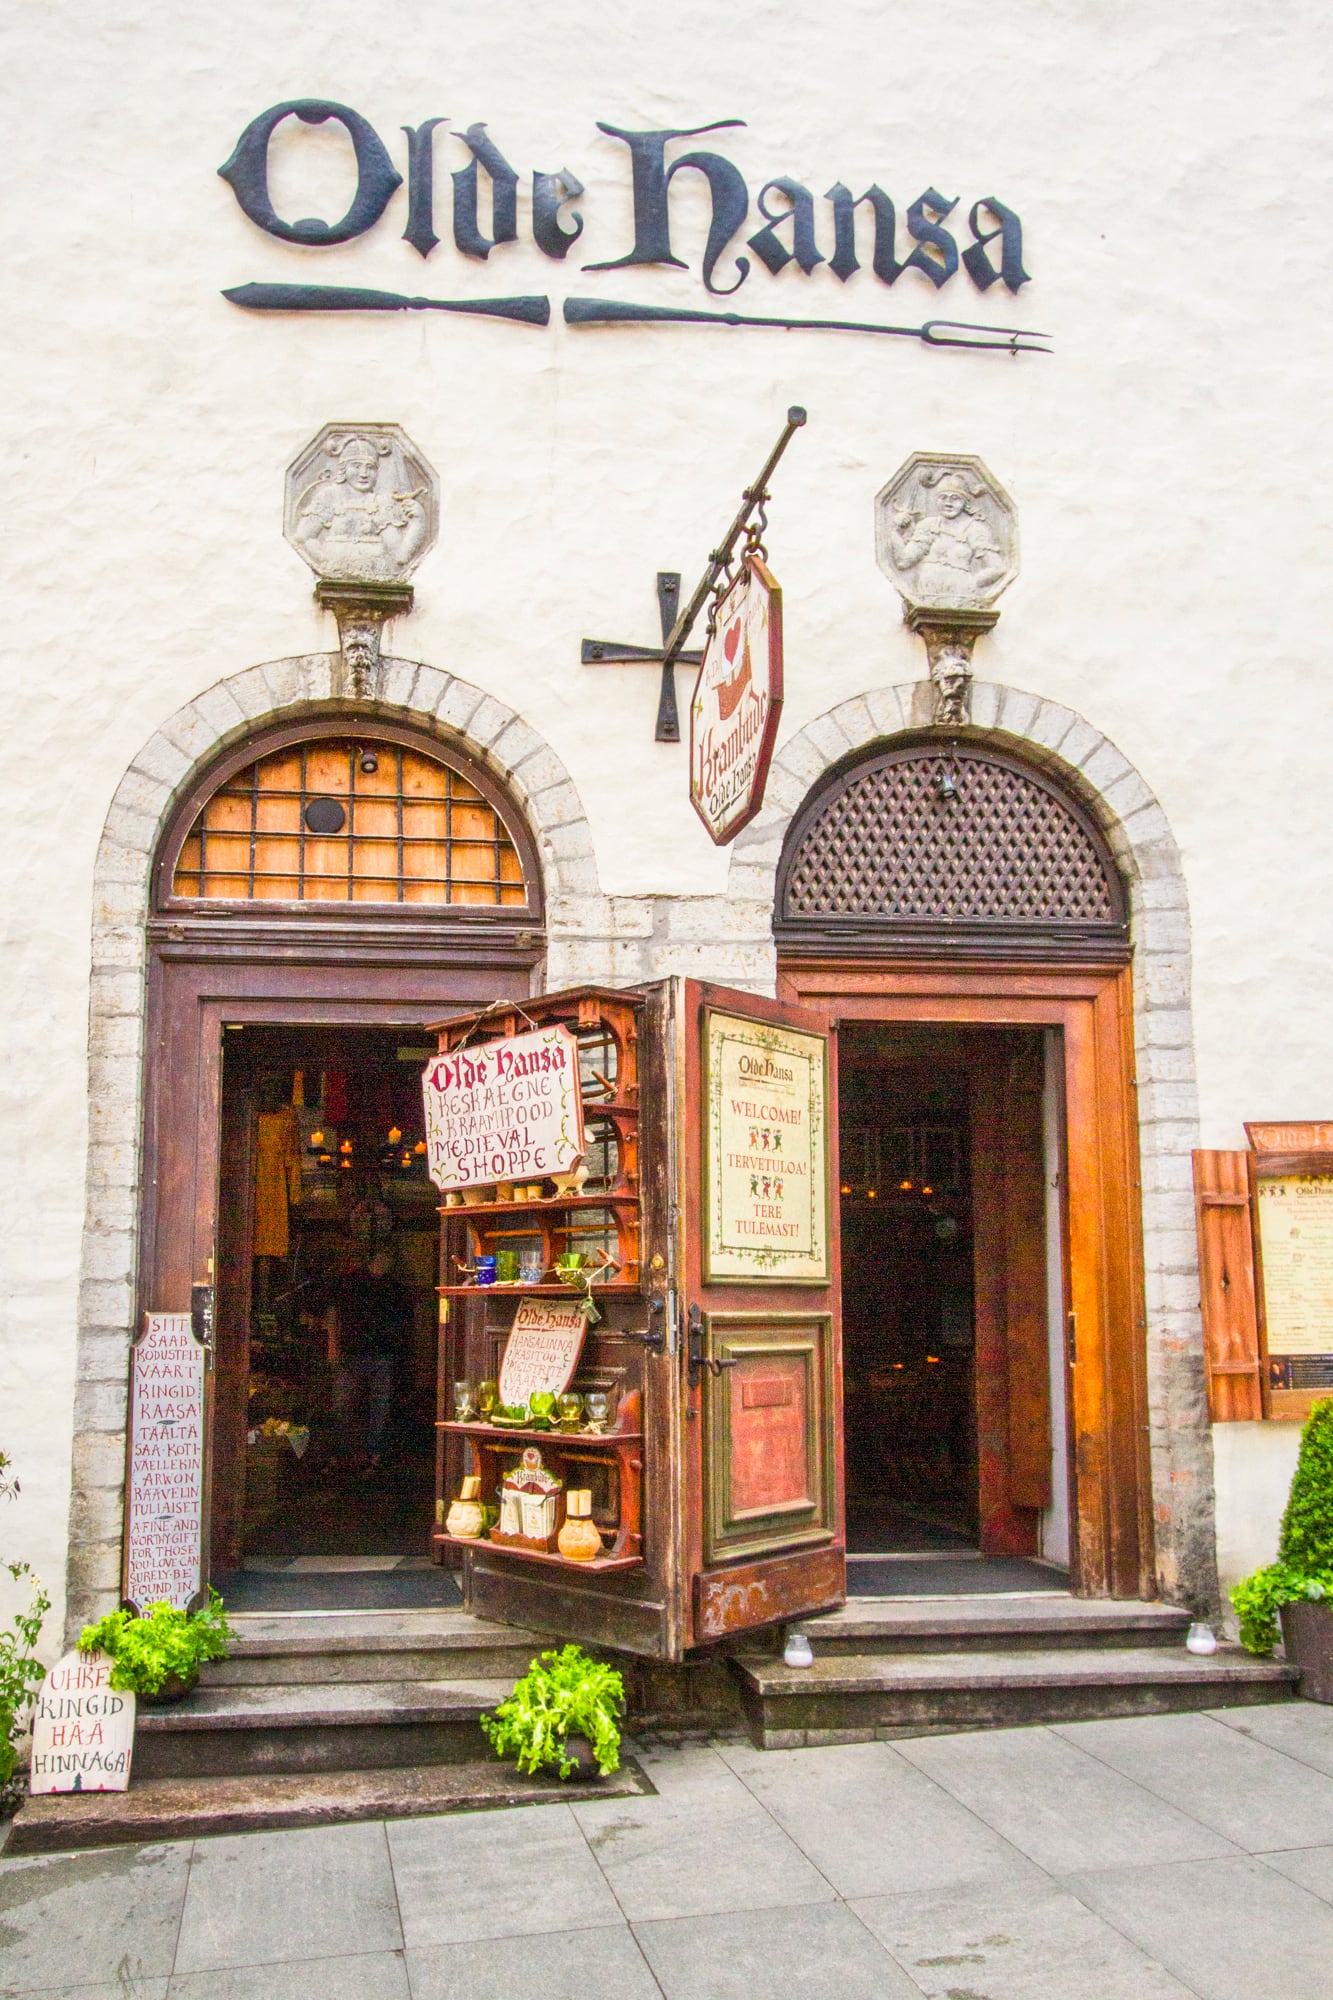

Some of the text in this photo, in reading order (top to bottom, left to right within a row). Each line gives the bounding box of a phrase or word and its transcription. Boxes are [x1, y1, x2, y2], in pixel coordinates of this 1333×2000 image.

[217, 98, 1033, 296] Olde Hansa
[428, 1043, 567, 1093] Olde Hansa
[738, 1055, 794, 1081] Olde Hansa
[437, 1076, 552, 1118] KESKAEGNE
[446, 1101, 553, 1140] KRAAMIPOOD
[730, 1099, 802, 1125] WELCOME!
[435, 1127, 536, 1163] MEDIEVAL
[457, 1147, 547, 1183] SHOPPE
[726, 1153, 807, 1176] TERVETULOA!
[753, 1203, 782, 1219] TERE
[735, 1219, 800, 1238] TULEMAST!
[152, 1318, 189, 1332] SIIT
[518, 1307, 582, 1329] Olde Hansa
[149, 1334, 189, 1348] SAAB
[138, 1383, 196, 1399] KINGID
[141, 1402, 202, 1419] KAASA!
[143, 1473, 194, 1487] ARWON
[133, 1501, 200, 1516] TULIAISET
[143, 1520, 170, 1533] FINE
[173, 1519, 199, 1532] AND
[131, 1532, 199, 1546] WORTHY GIFT
[132, 1545, 194, 1560] FOR THOSE
[130, 1555, 199, 1572] YOU LOVE CAN
[130, 1568, 192, 1584] SURELY BE
[131, 1581, 192, 1598] FOUND IN
[50, 1665, 110, 1690] UHKE
[38, 1695, 124, 1720] KINGID
[49, 1719, 105, 1749] HÄÄ
[33, 1748, 131, 1775] HINNAGA!
